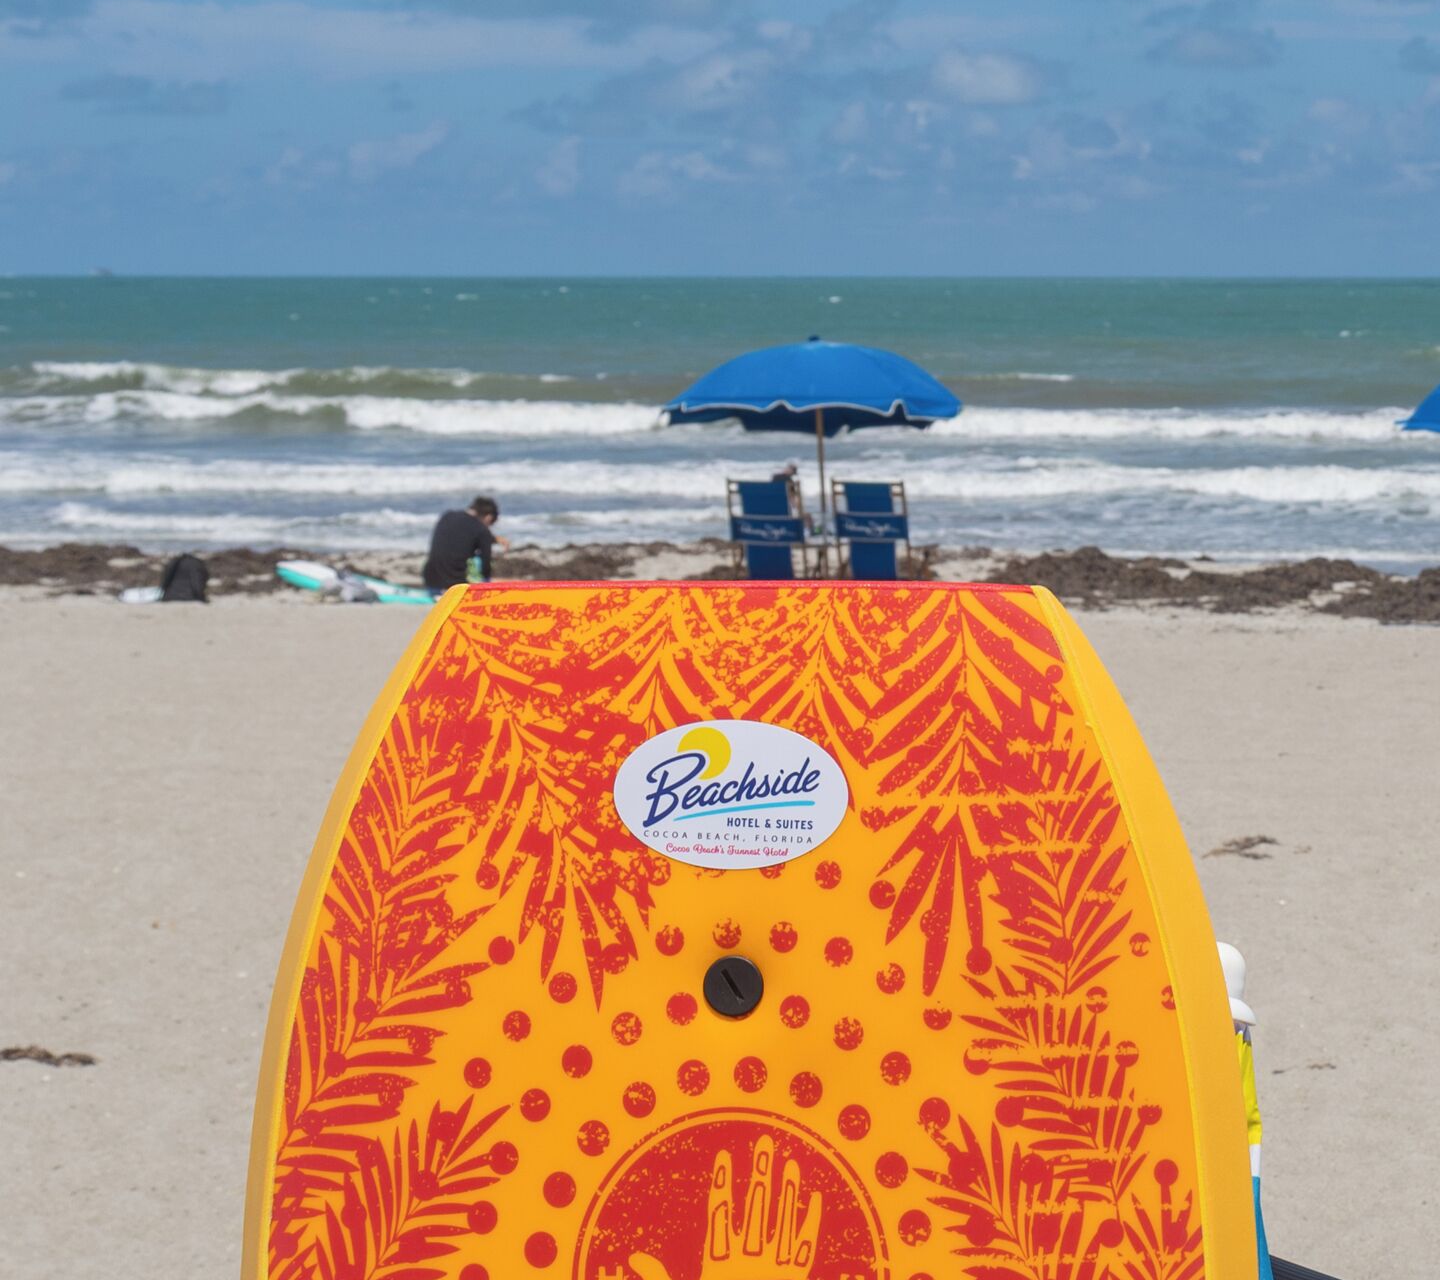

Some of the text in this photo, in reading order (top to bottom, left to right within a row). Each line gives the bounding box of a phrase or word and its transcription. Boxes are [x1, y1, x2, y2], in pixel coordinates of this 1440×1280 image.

[643, 752, 821, 828] Beachside
[726, 817, 813, 830] HOTEL & SUITES
[643, 829, 813, 845] COCOA BEACH, FLORIDA
[665, 843, 789, 857] Cocoa Beach's Funnest Hotel
